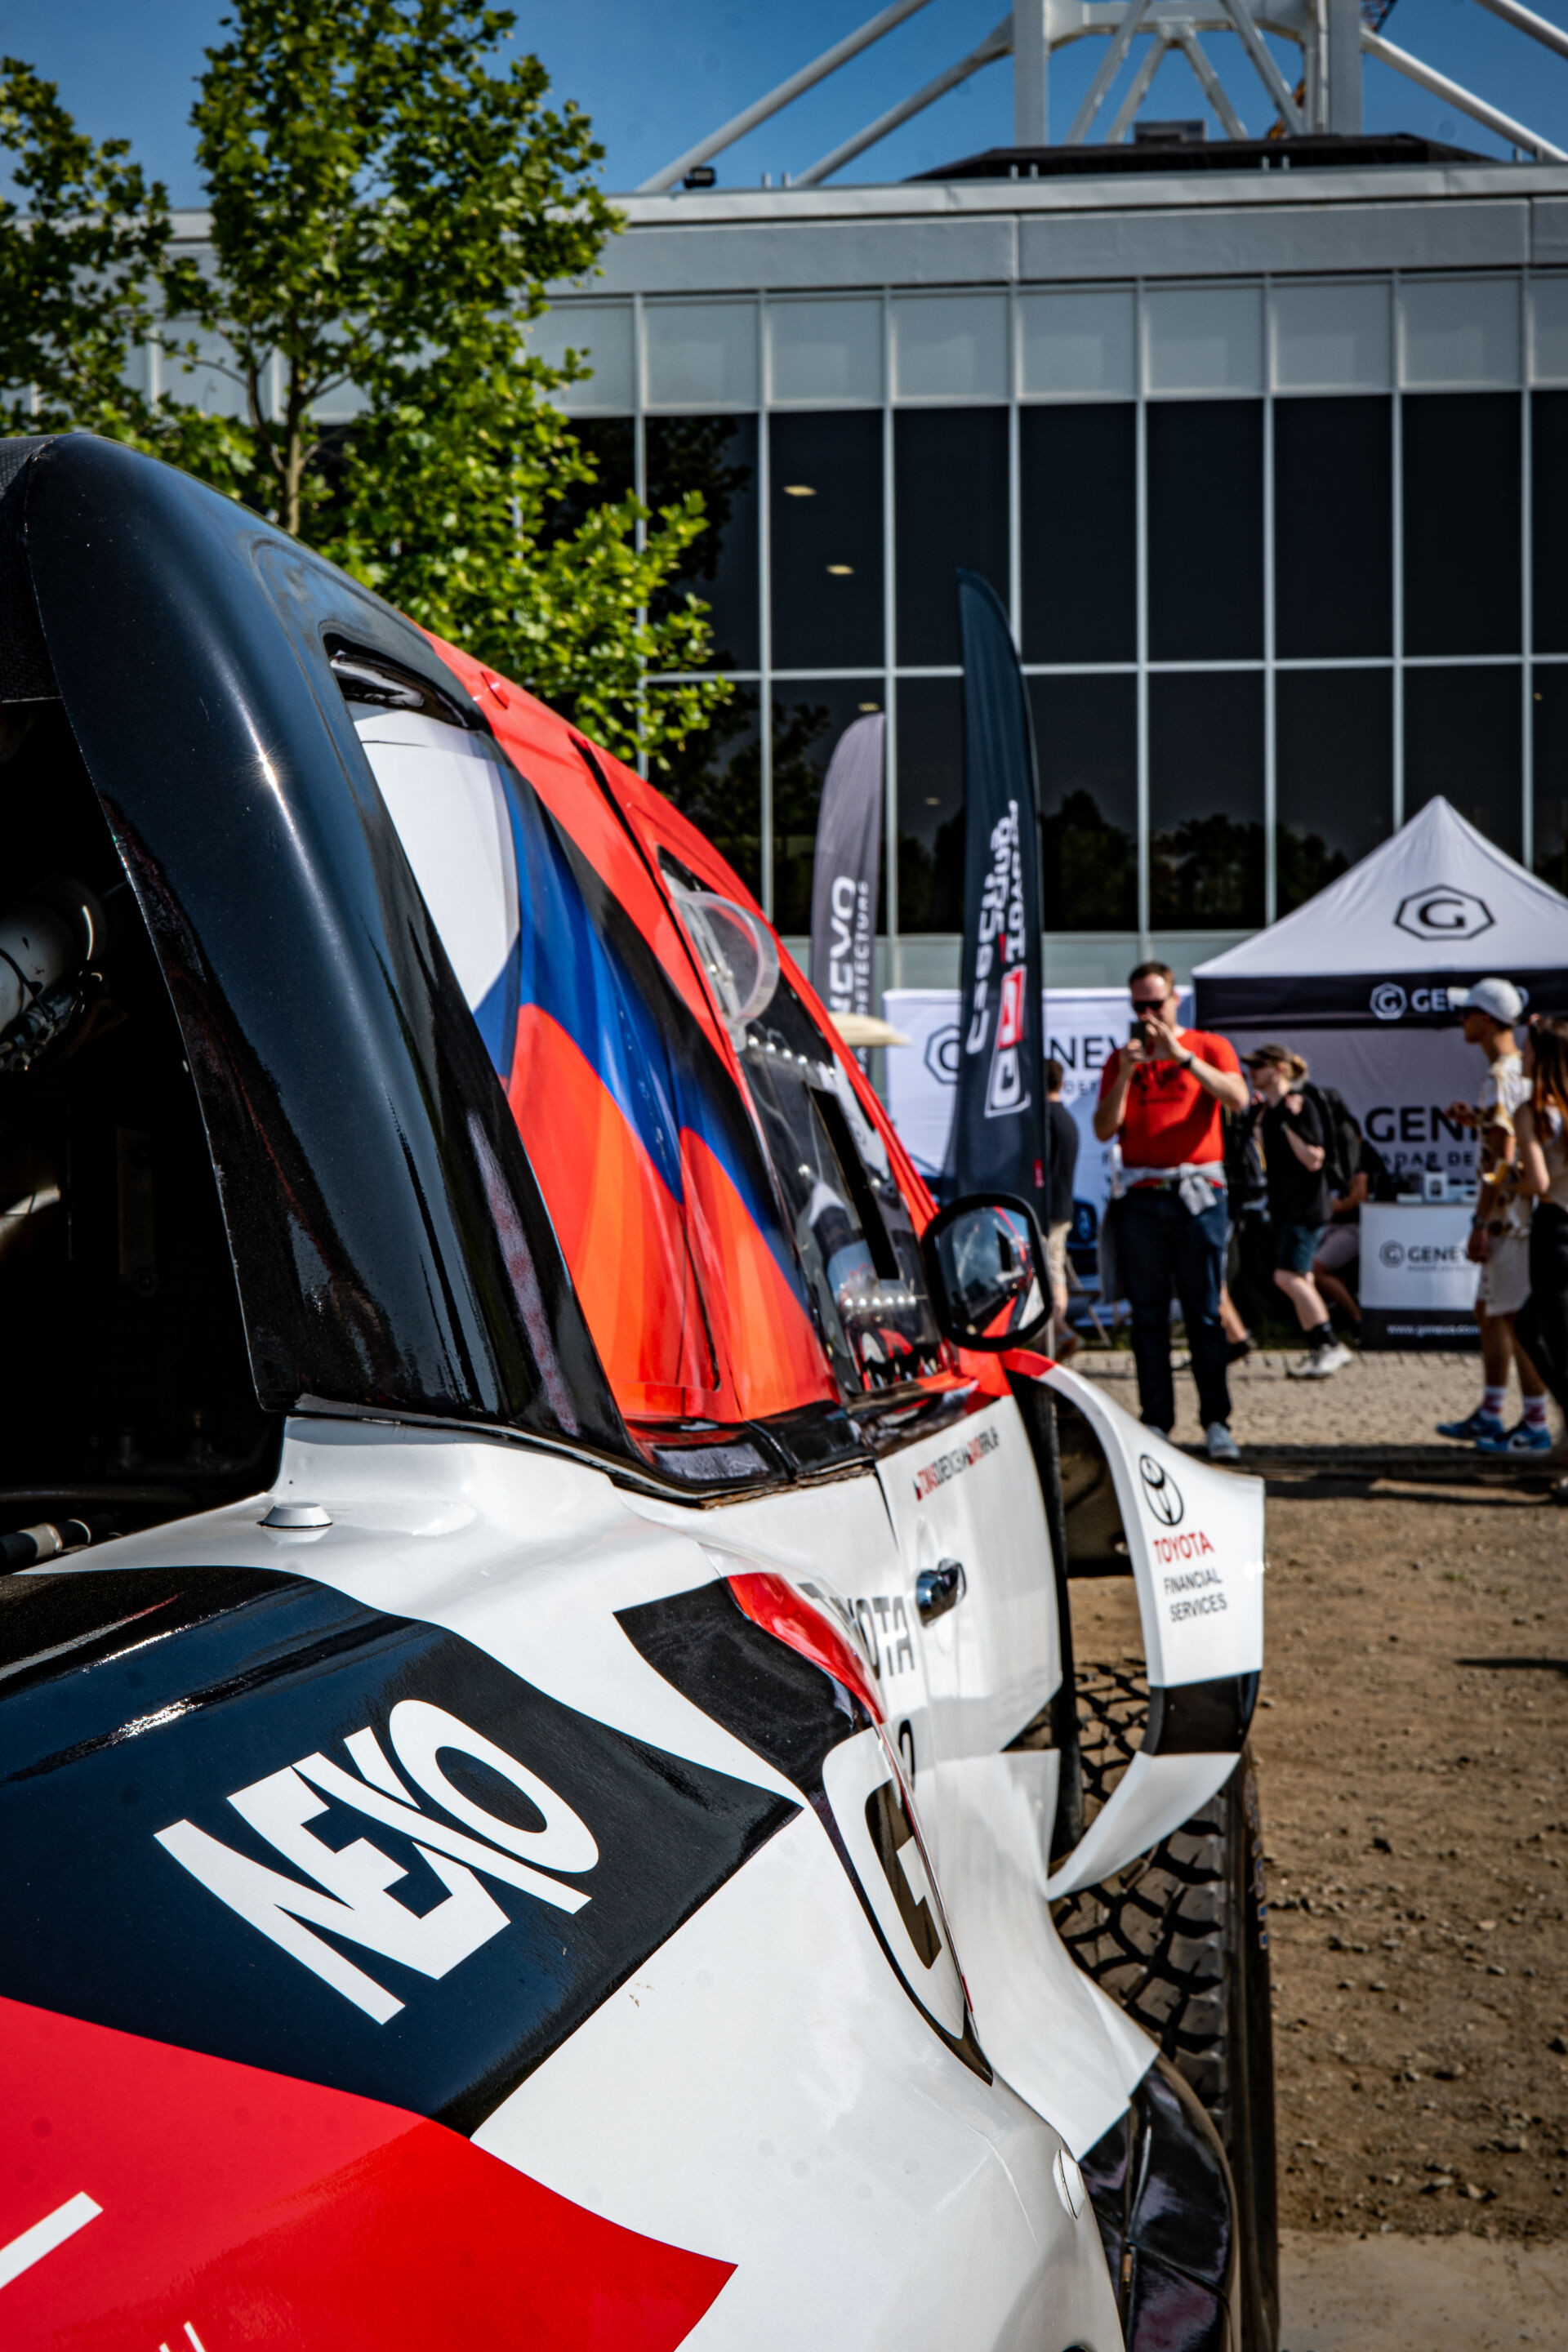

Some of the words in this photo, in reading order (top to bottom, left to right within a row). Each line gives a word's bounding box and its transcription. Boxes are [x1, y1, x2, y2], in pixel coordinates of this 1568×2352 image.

[1153, 1530, 1215, 1564] TOYOTA
[1163, 1567, 1223, 1596] FINANCIAL
[1170, 1592, 1229, 1623] SERVICES
[153, 1699, 599, 2026] NEXO
